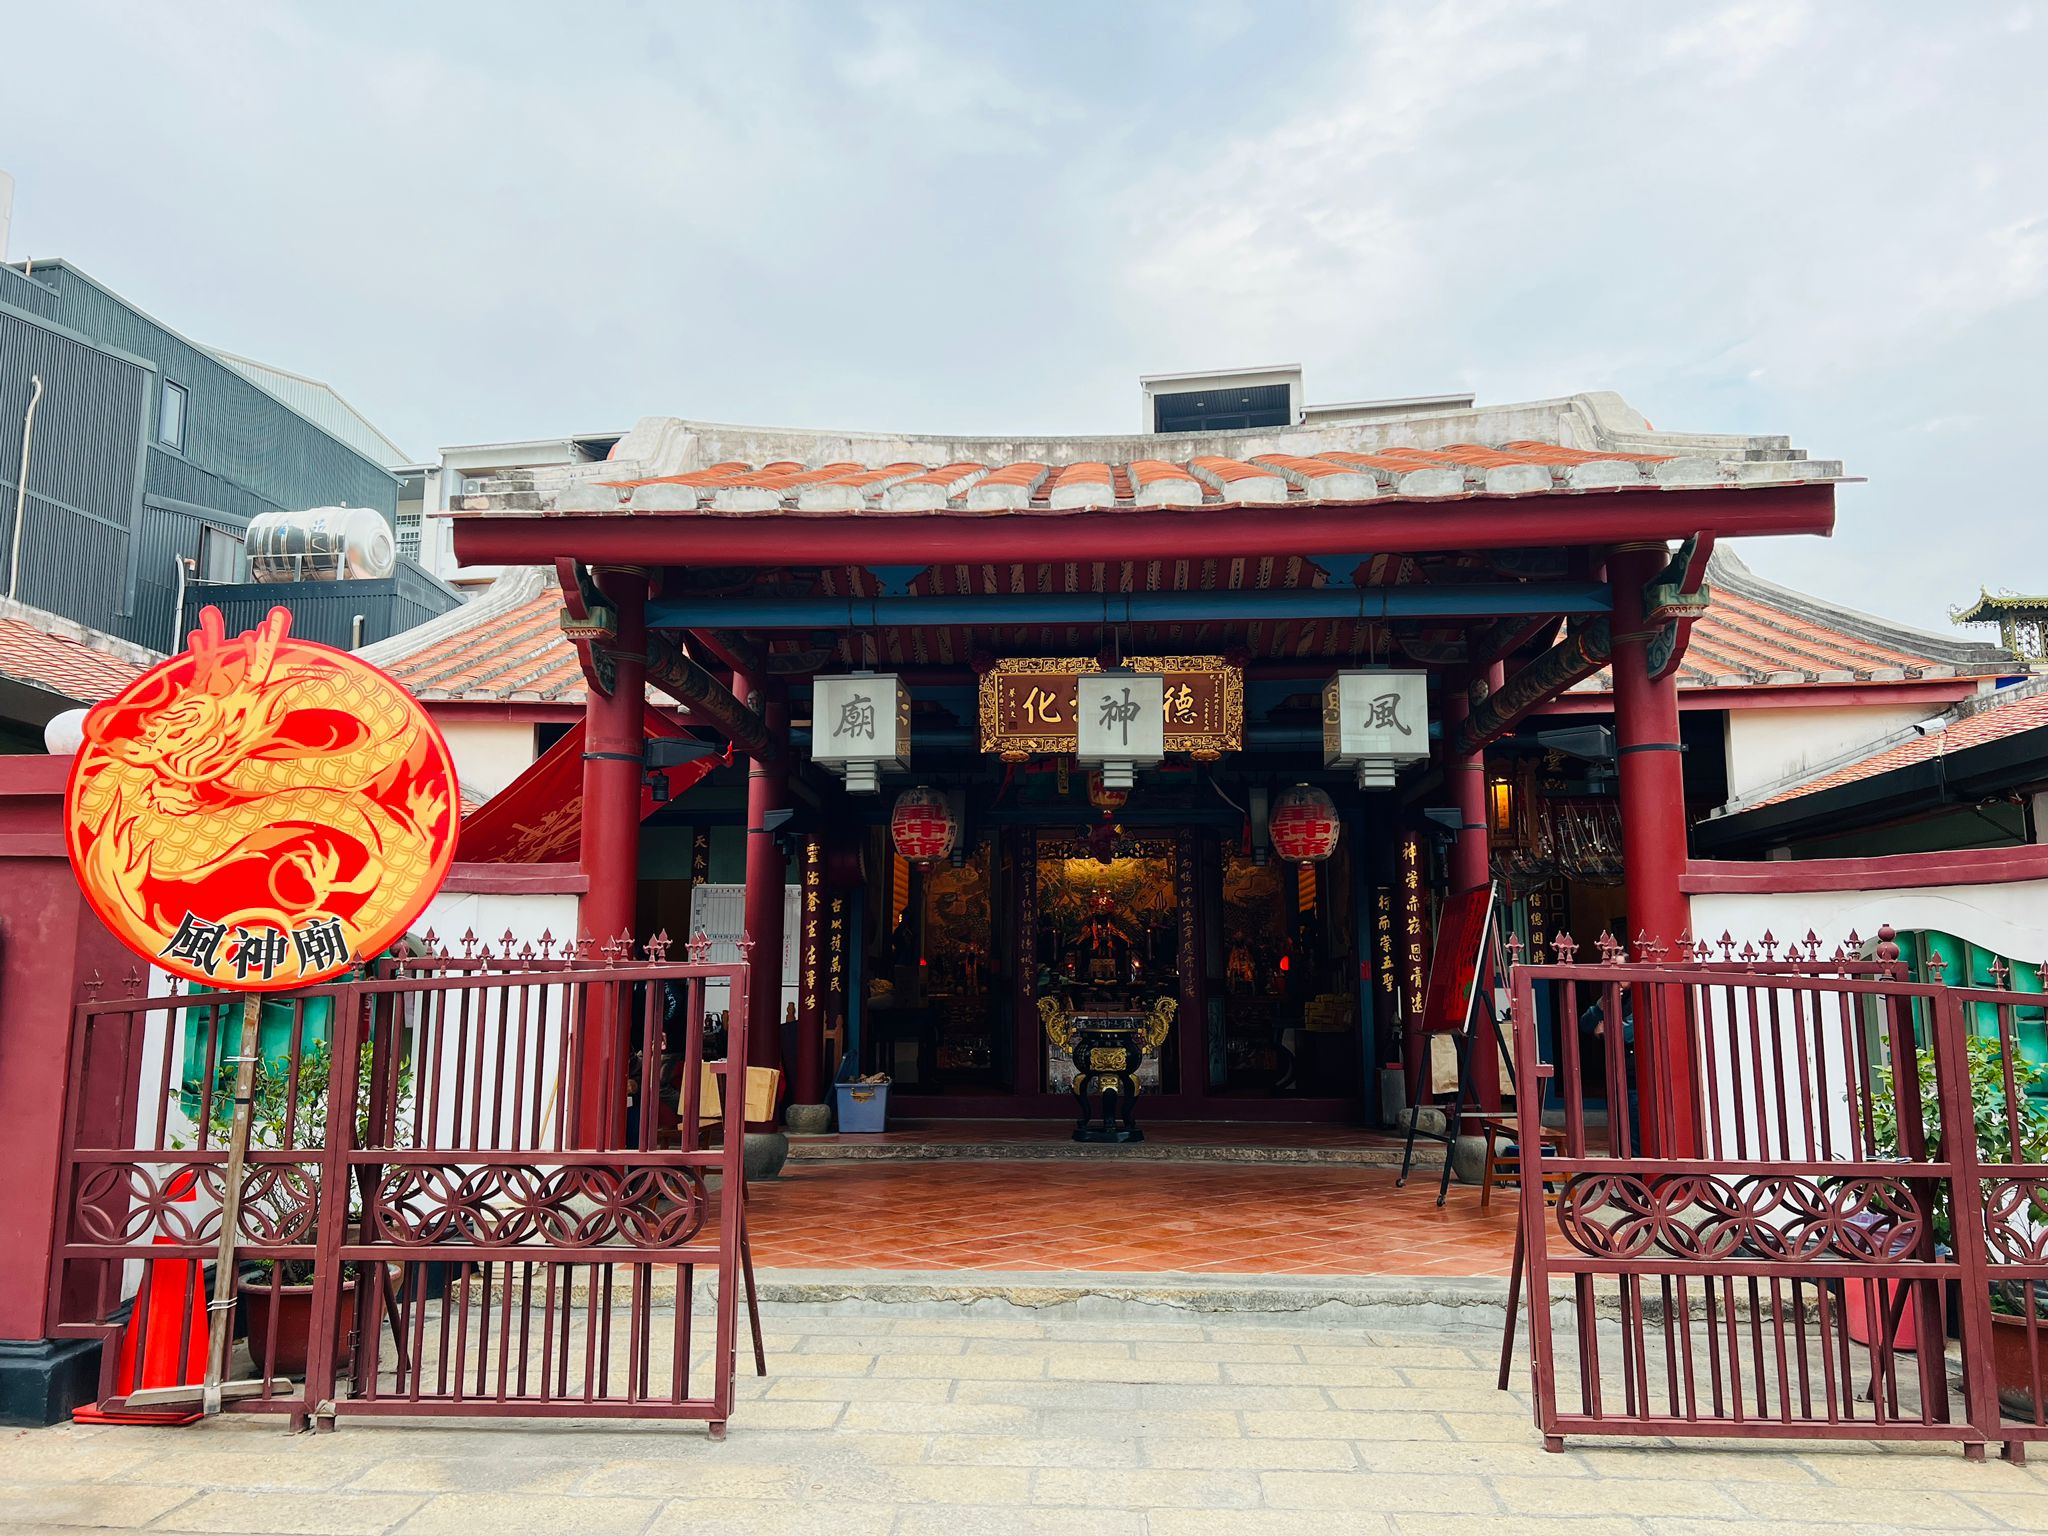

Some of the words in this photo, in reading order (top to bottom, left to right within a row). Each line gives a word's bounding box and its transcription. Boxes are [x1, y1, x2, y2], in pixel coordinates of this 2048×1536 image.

[832, 693, 876, 741] 廟
[1098, 687, 1142, 746] 神
[1363, 692, 1412, 738] 風
[159, 911, 350, 980] 風神廟
